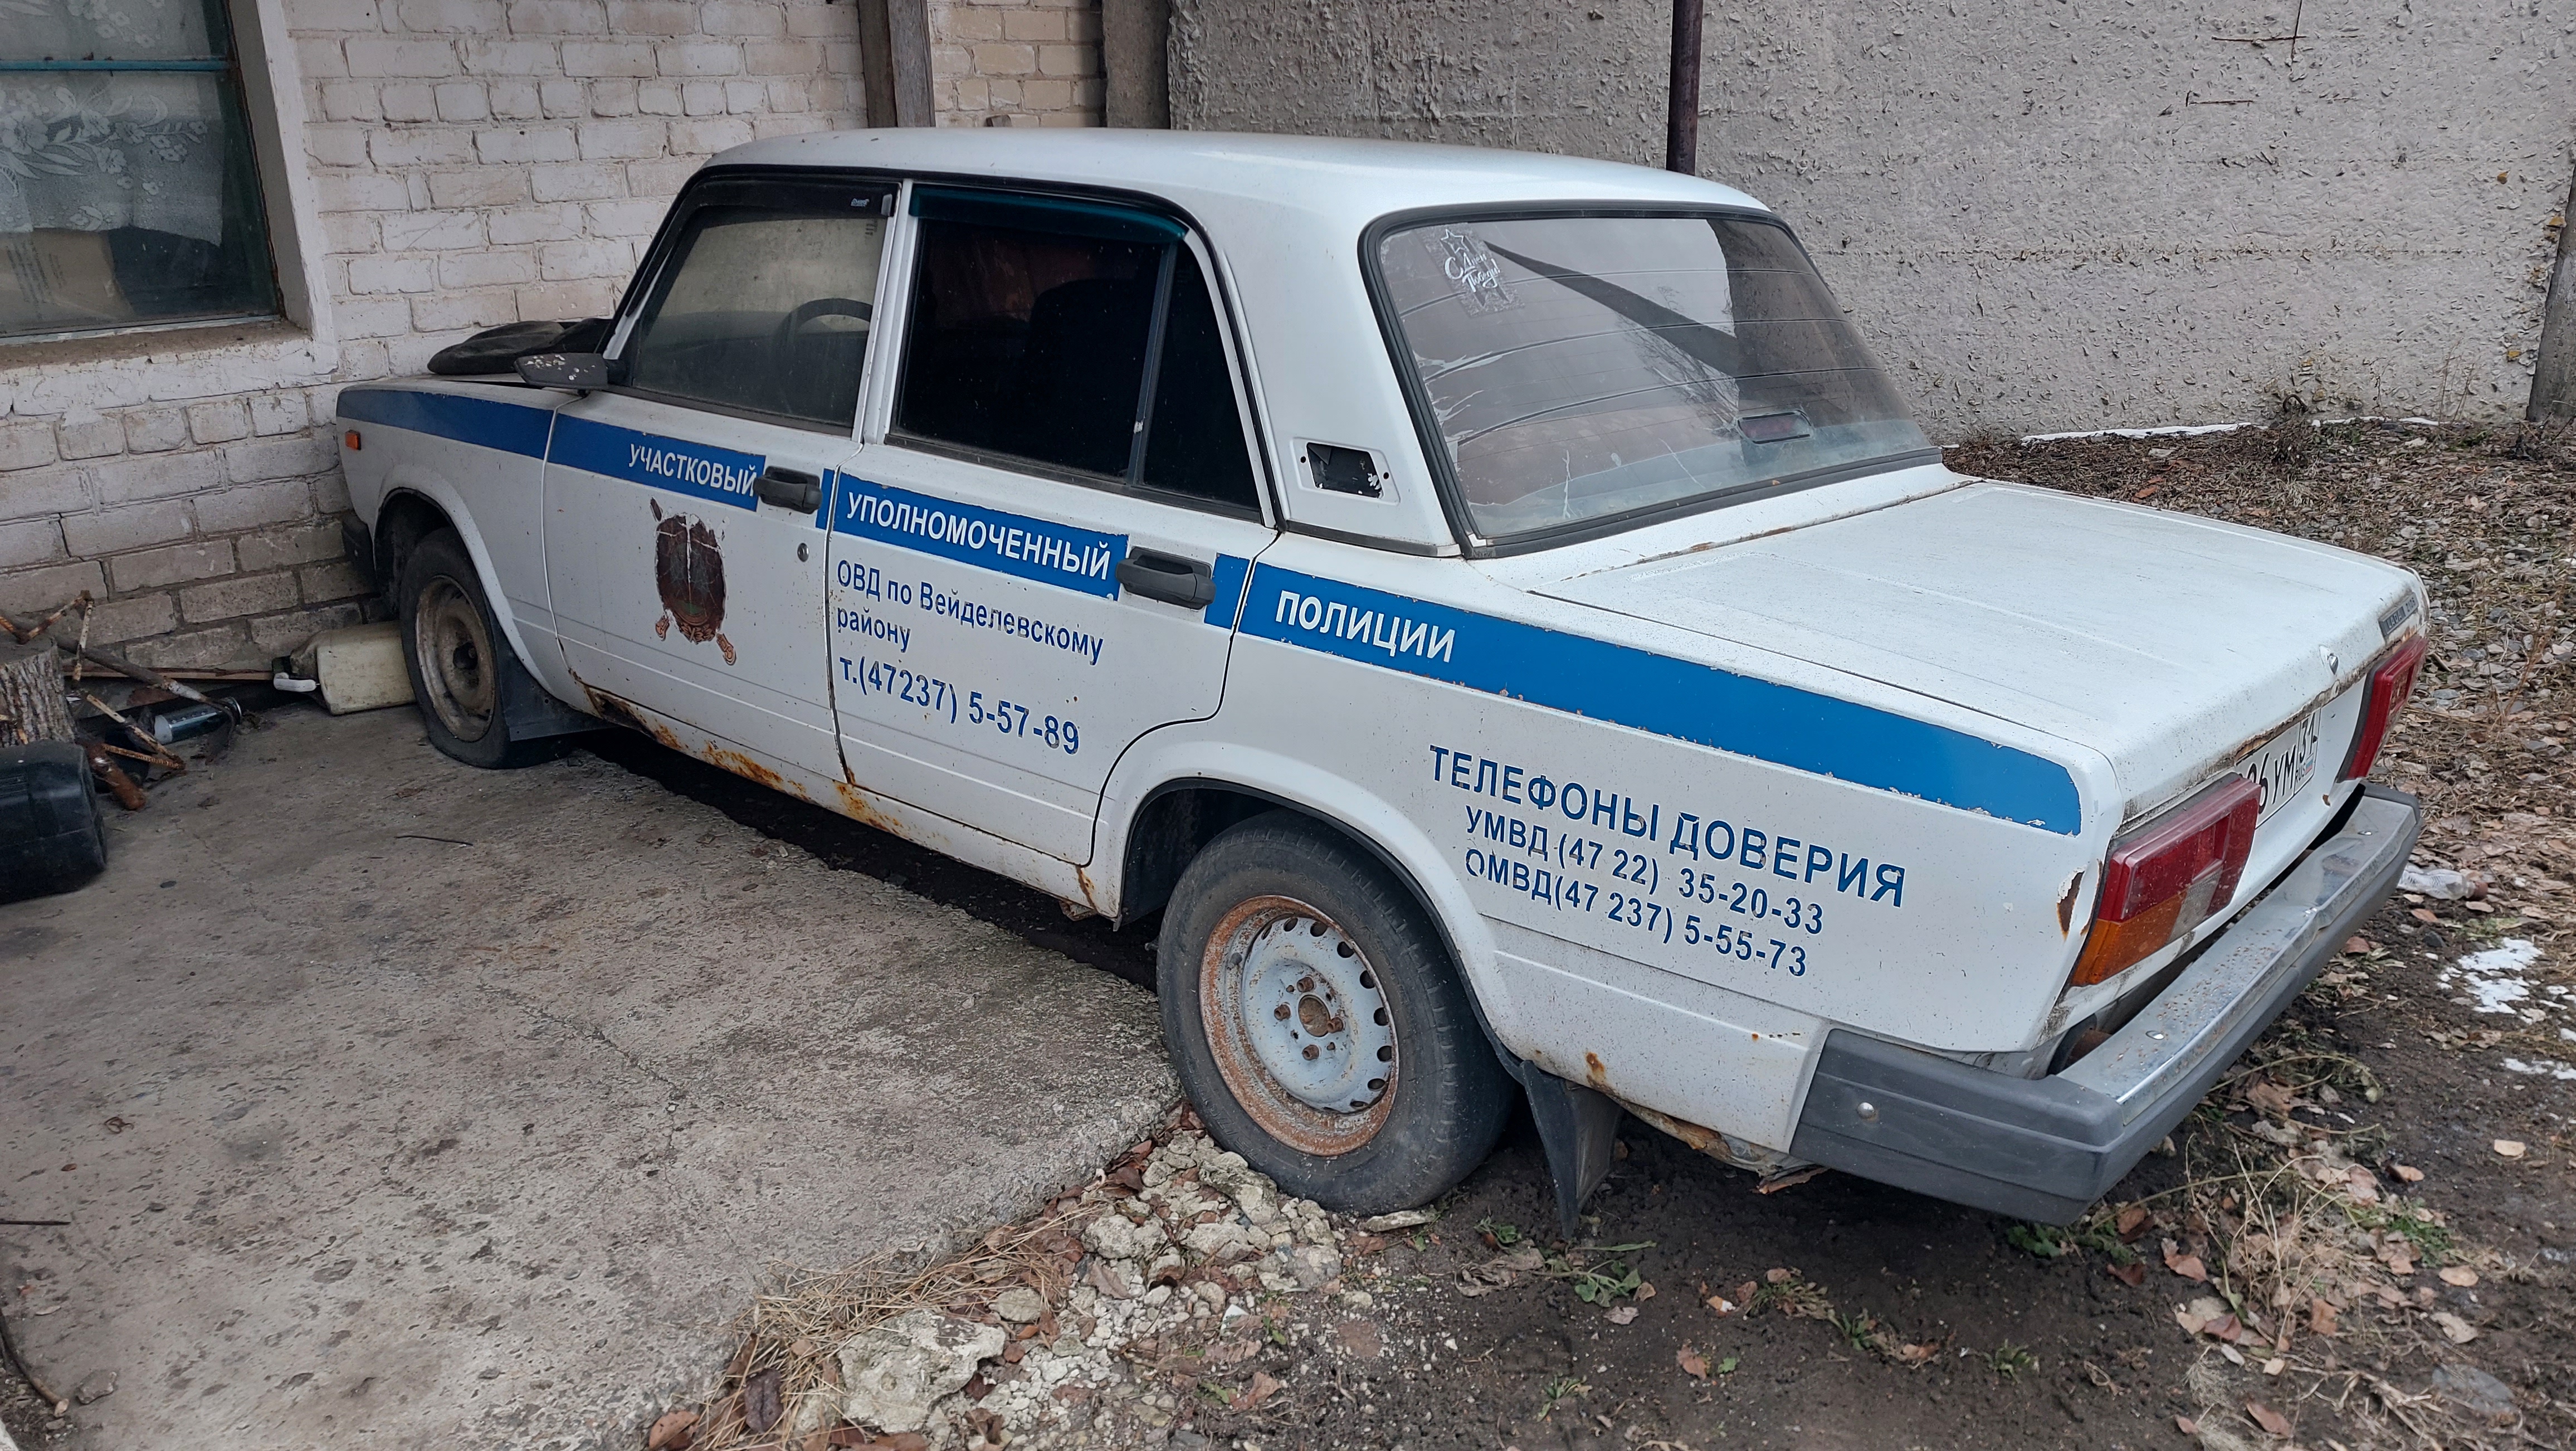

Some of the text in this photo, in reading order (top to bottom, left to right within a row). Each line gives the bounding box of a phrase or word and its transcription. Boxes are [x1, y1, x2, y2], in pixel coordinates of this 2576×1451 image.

[628, 443, 757, 497] УЧАСТКОВЫЙ
[846, 491, 1111, 580] УПОЛНОМОЧЕННЫЙ
[836, 559, 1105, 666] ОВД по Вейделевскому
[836, 605, 911, 654] району
[1275, 590, 1456, 663] ПОЛИЦИИ
[839, 656, 1081, 756] т.(47237) 5-57-89
[1429, 744, 1906, 908] ТЕЛЕФОНЫ ДОВЕРИЯ
[1465, 805, 1549, 863] УМВД
[1680, 867, 1824, 935] 35-20-33
[1684, 914, 1807, 977] 5-55-73
